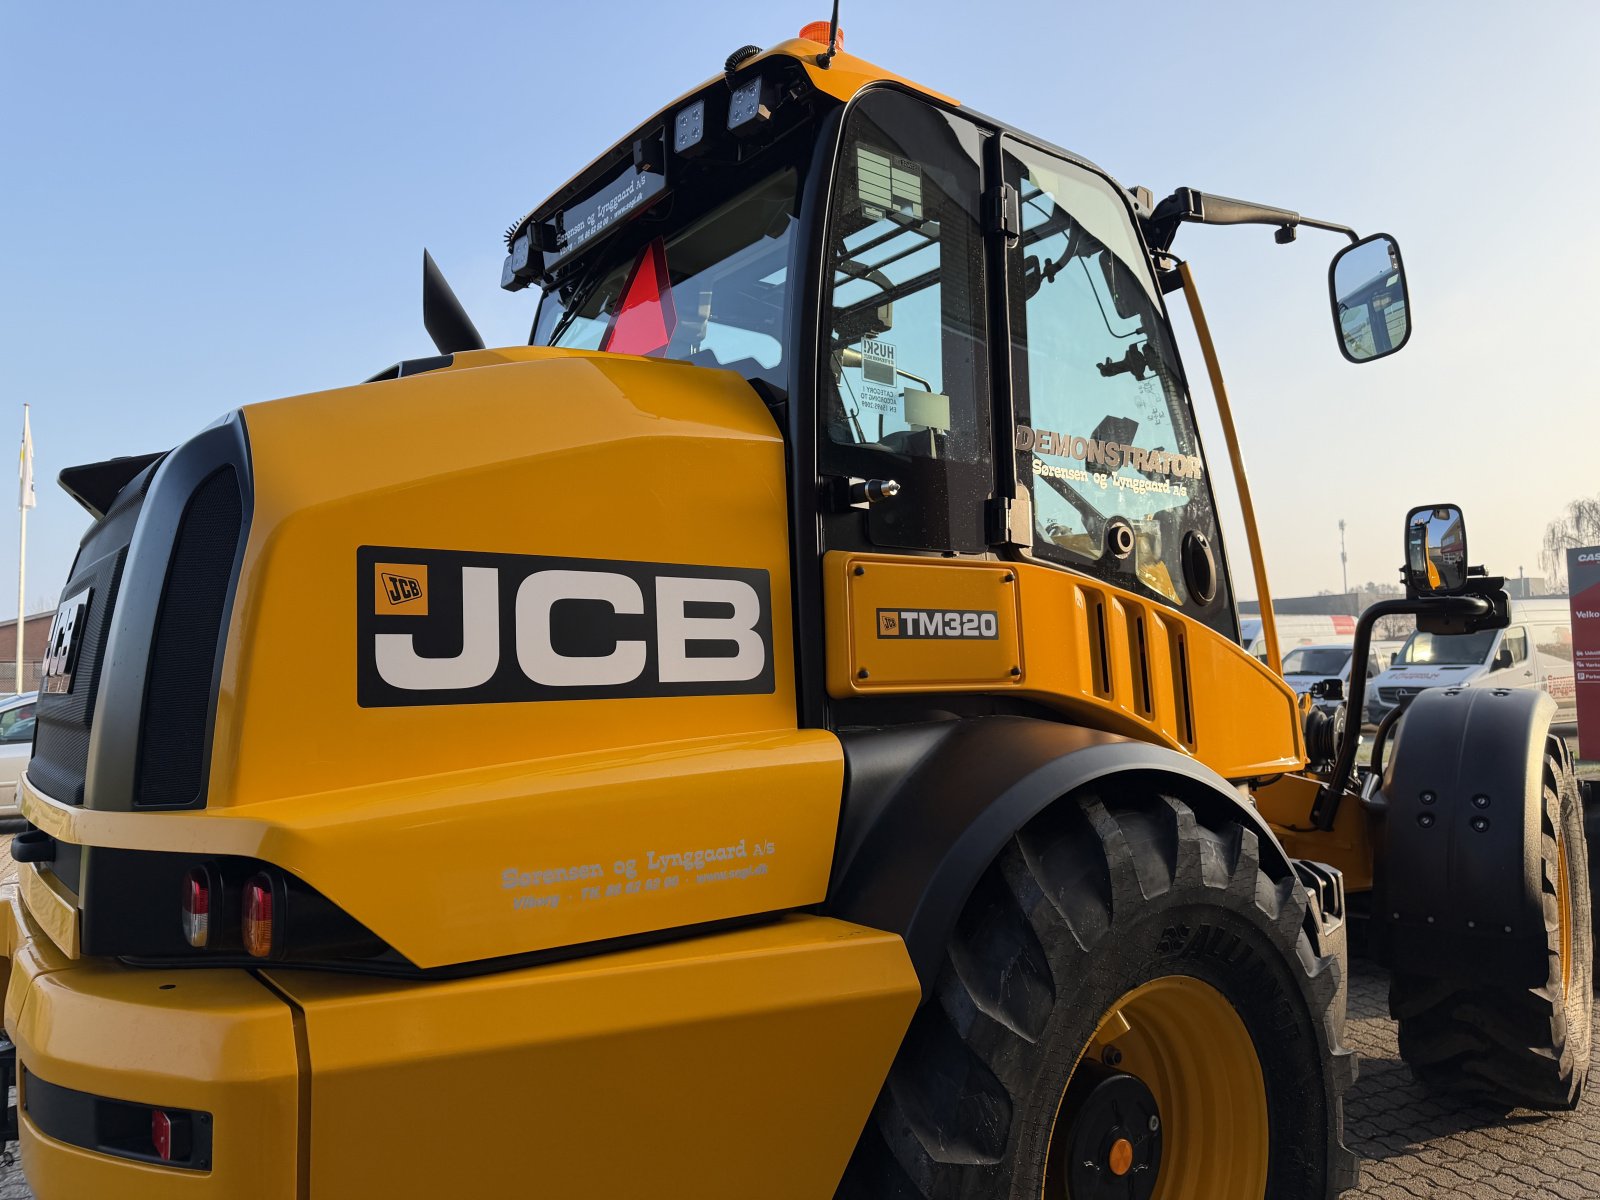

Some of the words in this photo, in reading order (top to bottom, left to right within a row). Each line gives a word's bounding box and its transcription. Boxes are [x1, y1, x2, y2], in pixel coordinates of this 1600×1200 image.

[587, 213, 596, 227] og
[597, 180, 635, 218] Lynggaard
[1015, 424, 1202, 479] DEMONSTRATOR
[1032, 459, 1088, 482] Sørensen
[1093, 472, 1108, 489] og
[1112, 471, 1171, 495] Lynggaard
[388, 574, 422, 604] JCB
[375, 566, 766, 690] JCB
[900, 611, 997, 637] TM320
[613, 858, 637, 879] og
[646, 839, 747, 873] Lynggaard
